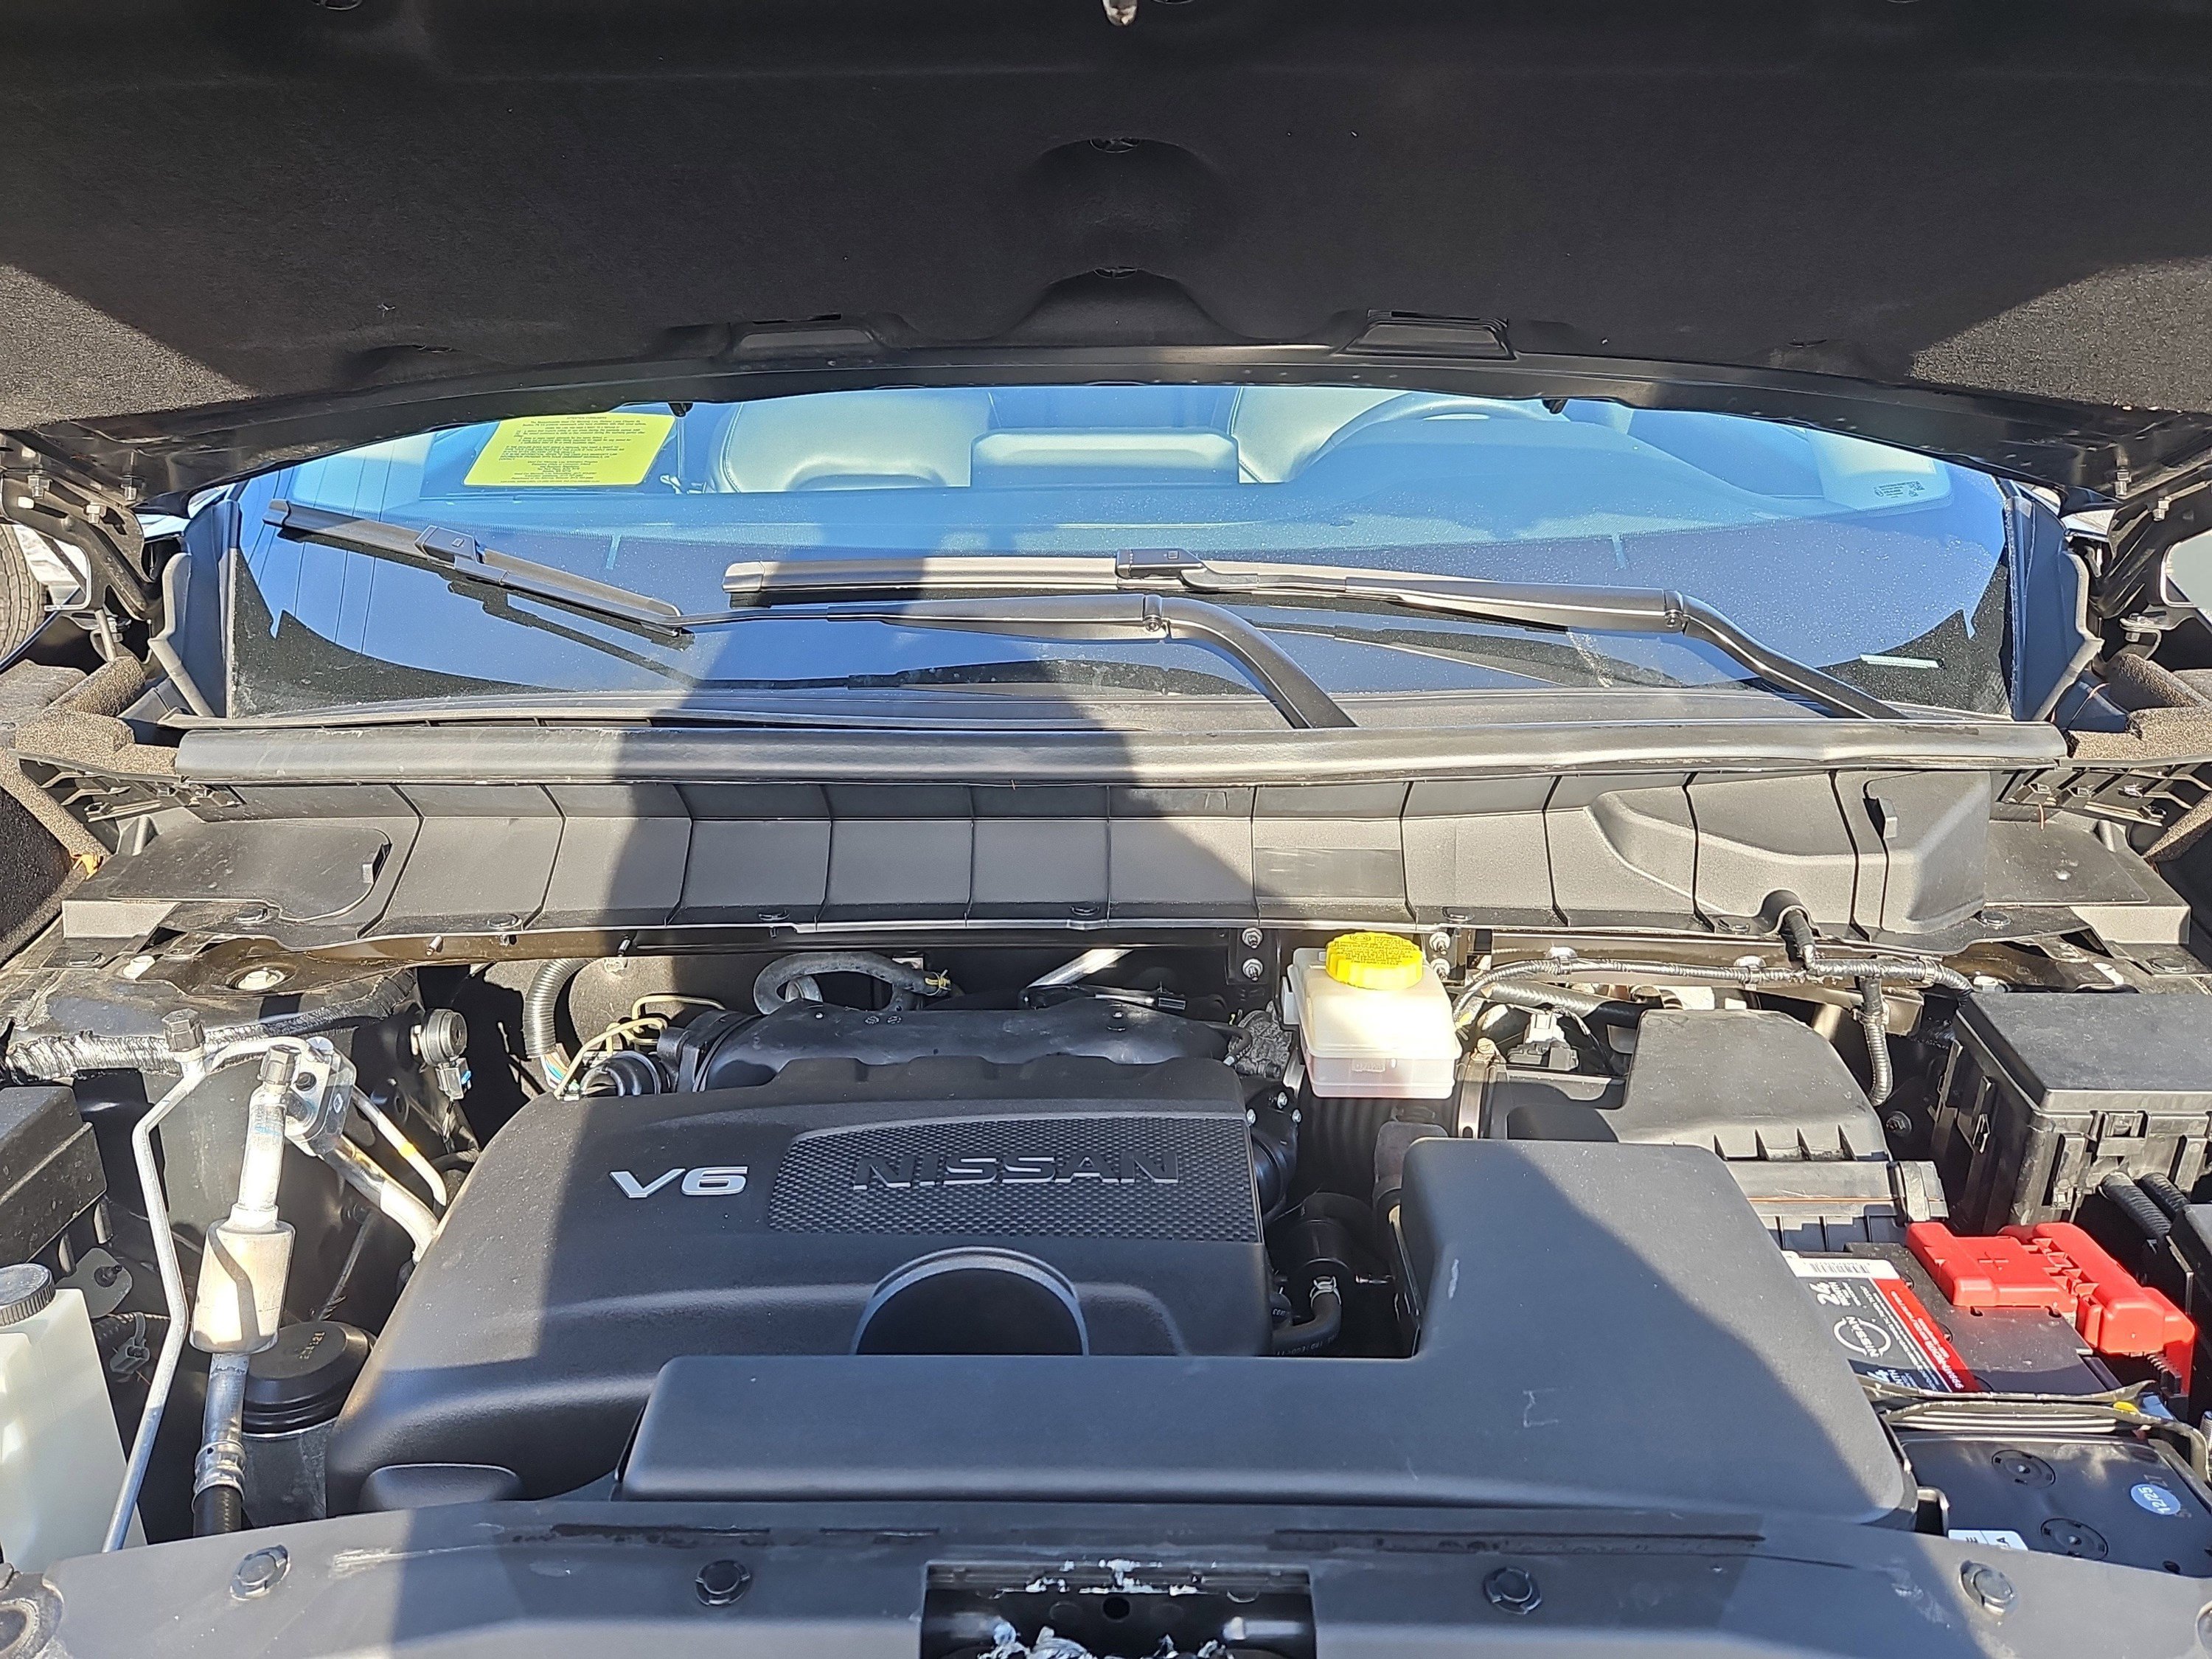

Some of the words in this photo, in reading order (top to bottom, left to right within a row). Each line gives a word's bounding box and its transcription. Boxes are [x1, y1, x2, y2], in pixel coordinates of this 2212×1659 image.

[609, 1166, 749, 1199] V6
[852, 1150, 1179, 1190] NISSAN
[1809, 1281, 1843, 1306] 24
[1827, 1281, 1852, 1306] MONTH
[1844, 1315, 1881, 1357] NISSAN
[2138, 1486, 2171, 1514] 12/25
